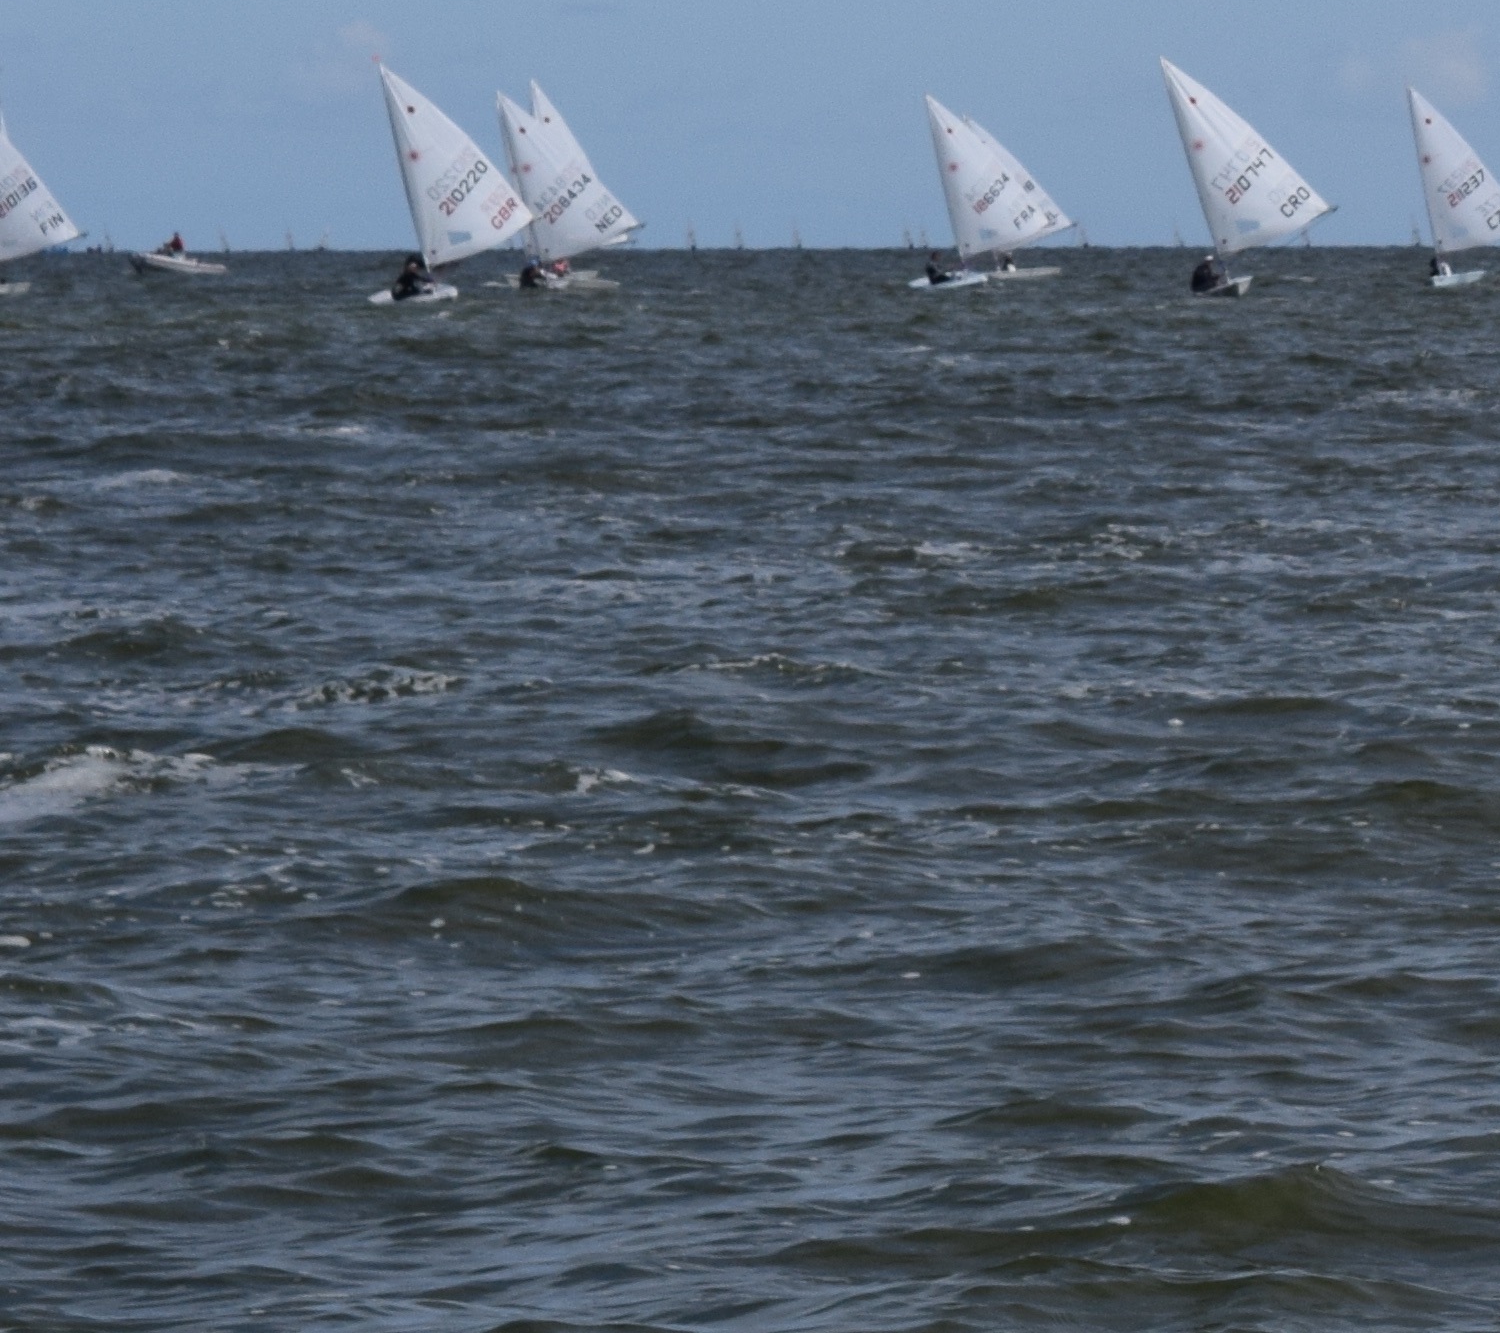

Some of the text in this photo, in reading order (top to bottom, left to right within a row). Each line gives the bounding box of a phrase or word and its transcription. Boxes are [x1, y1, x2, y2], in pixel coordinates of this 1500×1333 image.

[439, 160, 488, 217] 210220
[1225, 148, 1274, 205] 210747
[1447, 168, 1485, 208] 211237
[490, 197, 519, 231] GBR
[1013, 205, 1035, 231] FRA
[1280, 186, 1310, 218] CRO
[39, 213, 65, 236] FIN
[594, 205, 624, 233] NED
